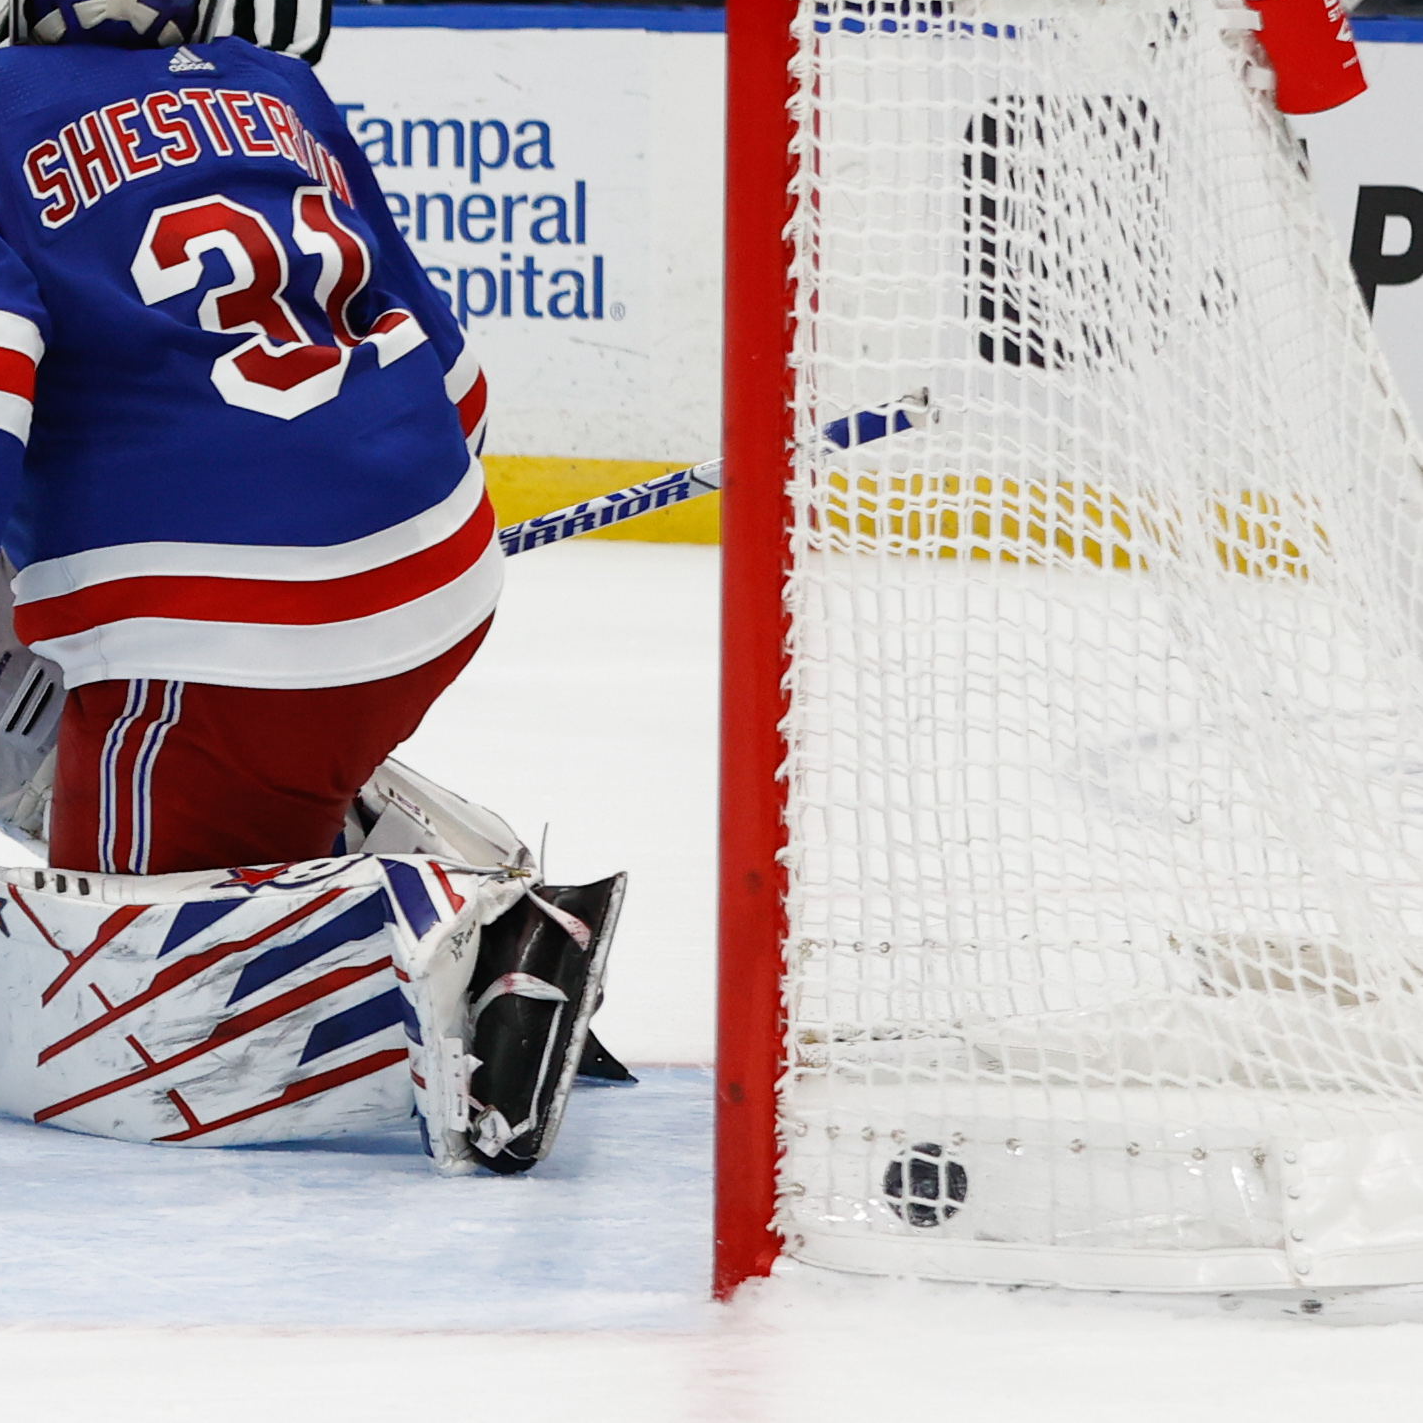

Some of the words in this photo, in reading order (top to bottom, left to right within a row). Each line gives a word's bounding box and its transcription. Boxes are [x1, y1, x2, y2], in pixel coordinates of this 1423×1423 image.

[168, 60, 215, 73] adidas
[384, 180, 586, 245] eneral
[131, 187, 428, 420] 31
[424, 252, 604, 331] spital
[497, 480, 691, 557] ARRIOR
